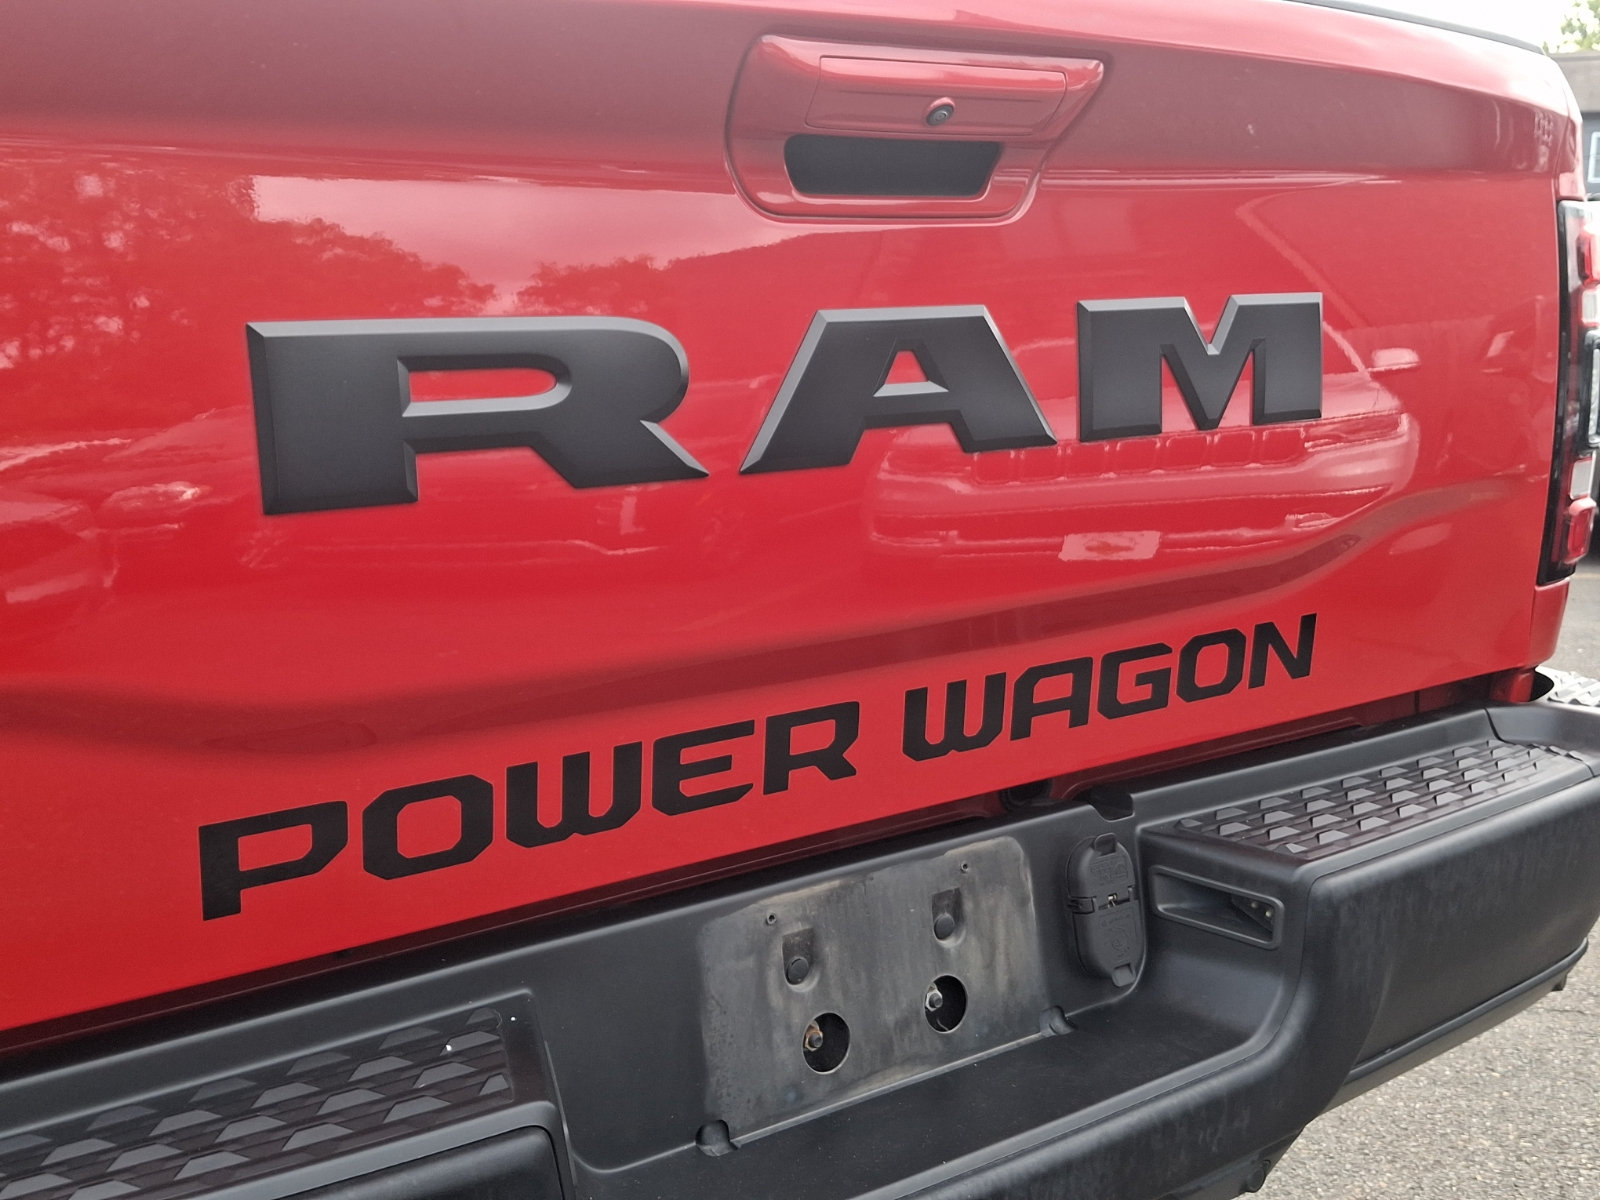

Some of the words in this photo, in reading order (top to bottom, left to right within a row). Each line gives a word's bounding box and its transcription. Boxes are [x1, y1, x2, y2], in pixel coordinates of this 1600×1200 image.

[246, 292, 1324, 515] RAM
[199, 702, 860, 921] POWER
[903, 614, 1317, 761] WAGON
